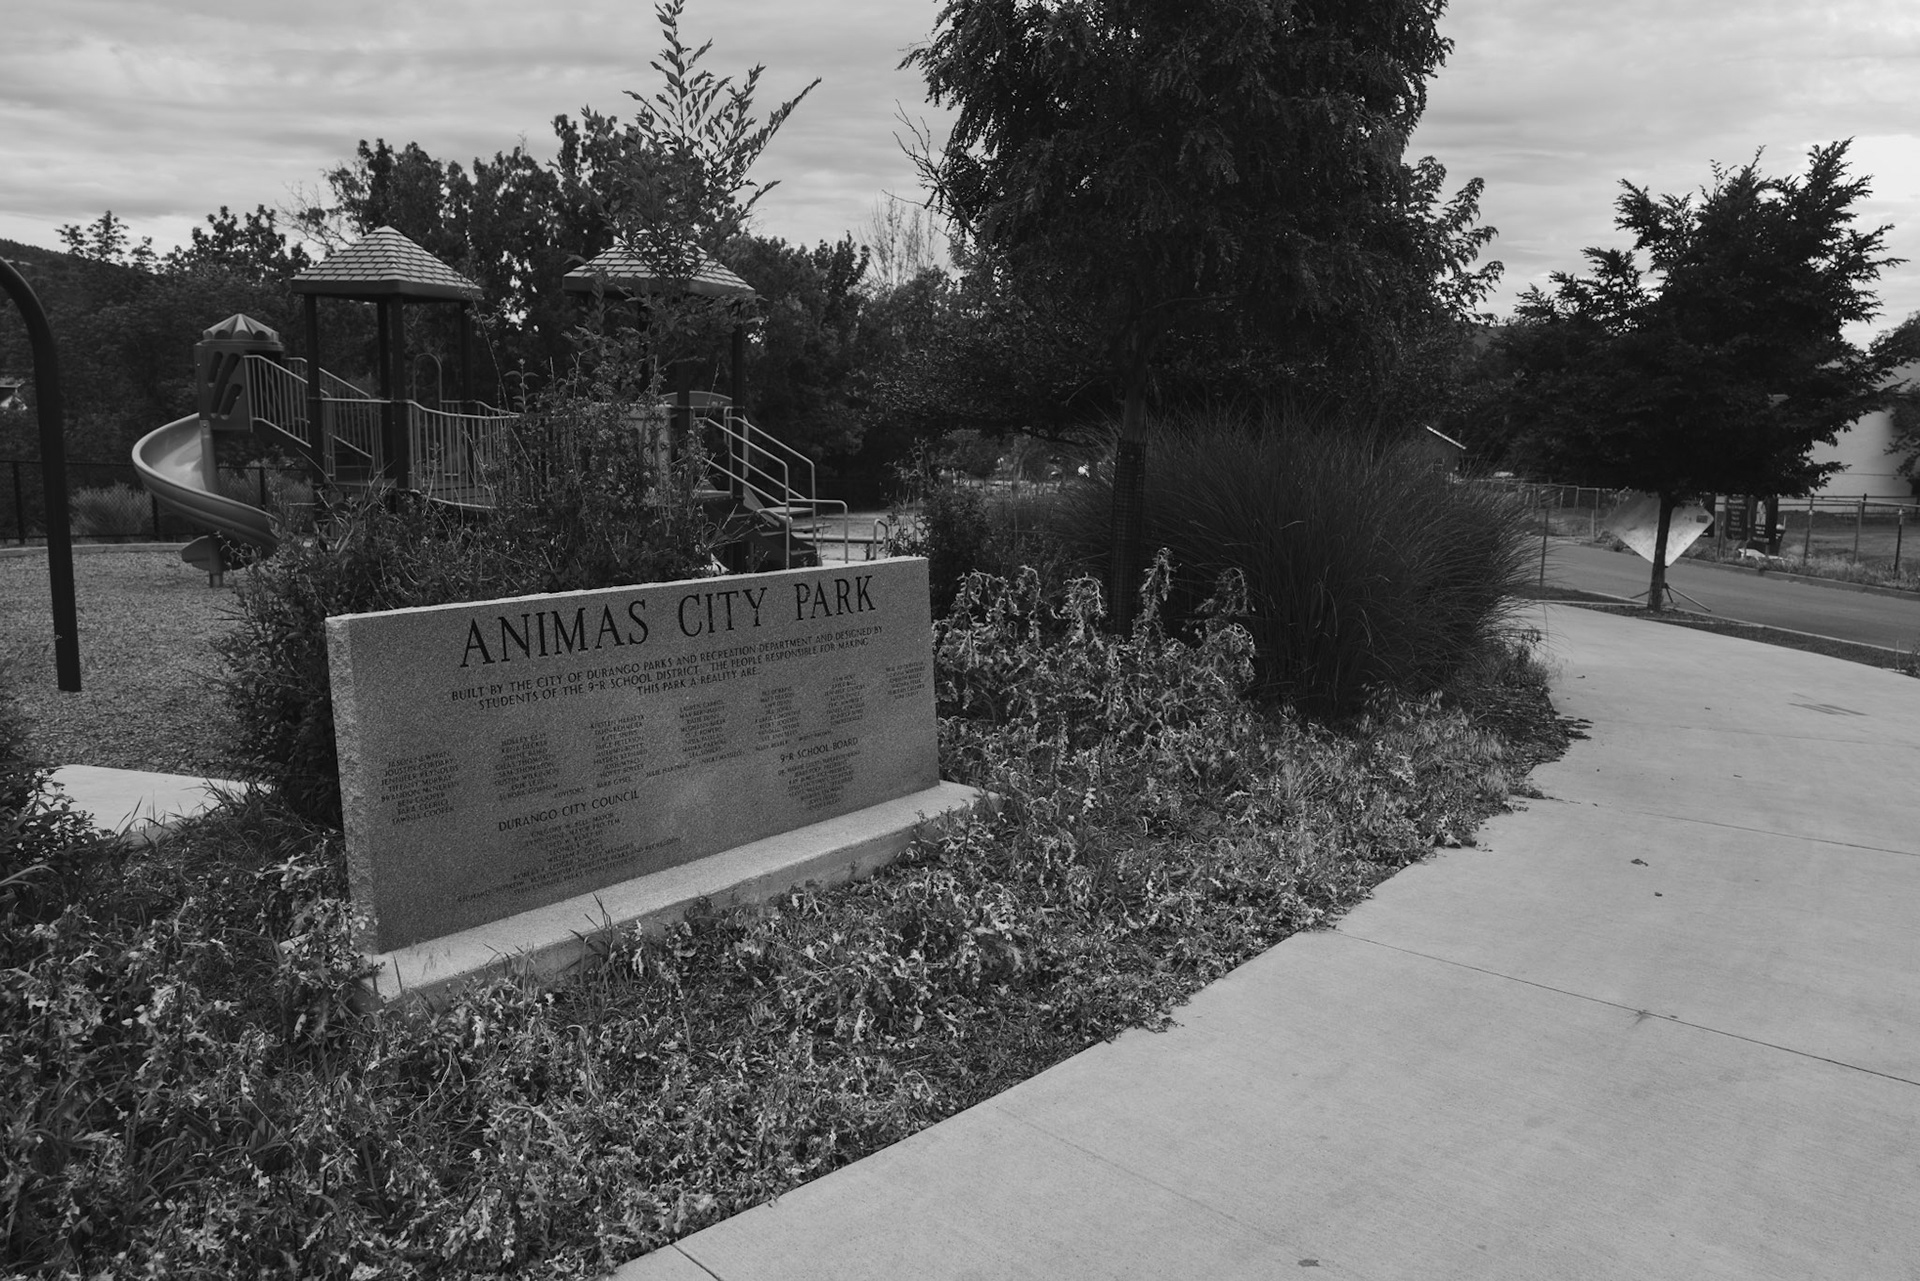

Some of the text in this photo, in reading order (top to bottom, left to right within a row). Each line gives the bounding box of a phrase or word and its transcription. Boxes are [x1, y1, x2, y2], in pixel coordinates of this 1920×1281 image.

[460, 575, 875, 667] ANIMAS CITY PARK
[452, 626, 882, 702] BUILT BY THE CITY OF DURANGO PARKS AND RECREATION DEPARTMENT AND DESIGNED BY
[479, 692, 538, 711] STUDENTS
[543, 689, 557, 700] OF
[563, 685, 583, 697] THE
[589, 681, 606, 692] 9-R
[611, 674, 651, 688] SCHOOL
[711, 661, 727, 671] THE
[731, 656, 761, 668] PEOPLE
[766, 647, 816, 662] RESPONSIBLE
[820, 644, 834, 653] FOR
[838, 638, 868, 650] MAKING
[638, 684, 659, 696] THIS
[663, 680, 685, 691] PARK
[690, 678, 697, 687] A
[701, 671, 736, 685] REALITY
[780, 737, 858, 763] 9-R SCHOOL BOARD
[499, 790, 639, 832] DURANGO CITY COUNCIL
